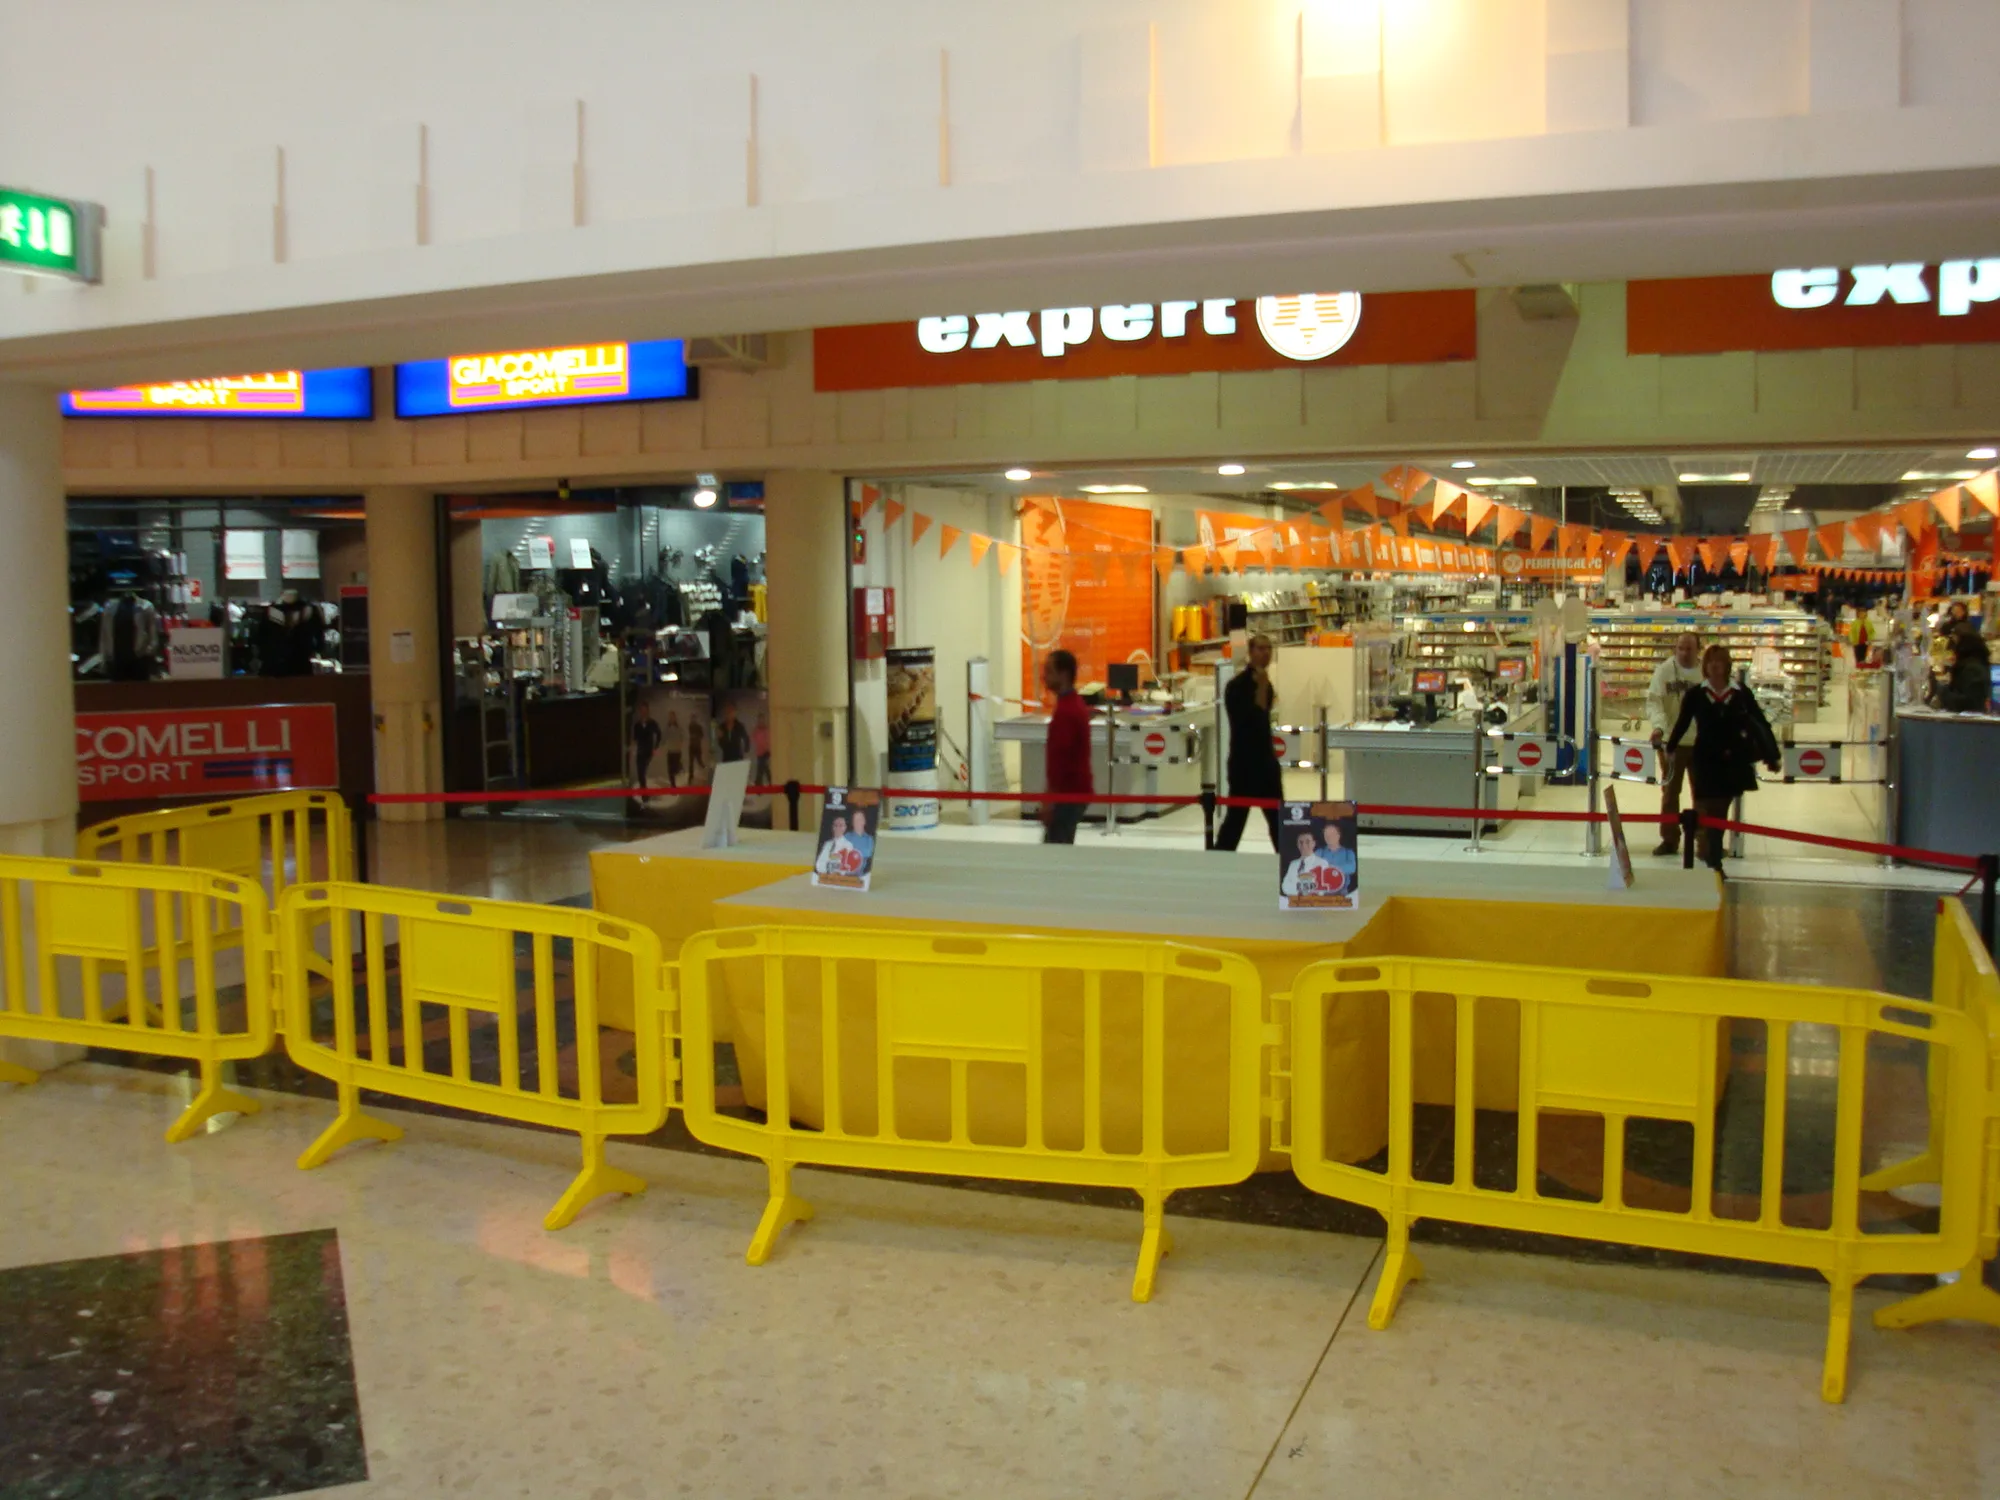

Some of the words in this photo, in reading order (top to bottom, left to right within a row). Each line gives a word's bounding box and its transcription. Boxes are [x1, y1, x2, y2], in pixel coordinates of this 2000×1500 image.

[917, 297, 1237, 357] expert
[453, 345, 624, 385] GIACOMELLI
[149, 388, 231, 405] SPORT
[505, 377, 568, 396] SPORT
[78, 761, 193, 785] SPORT
